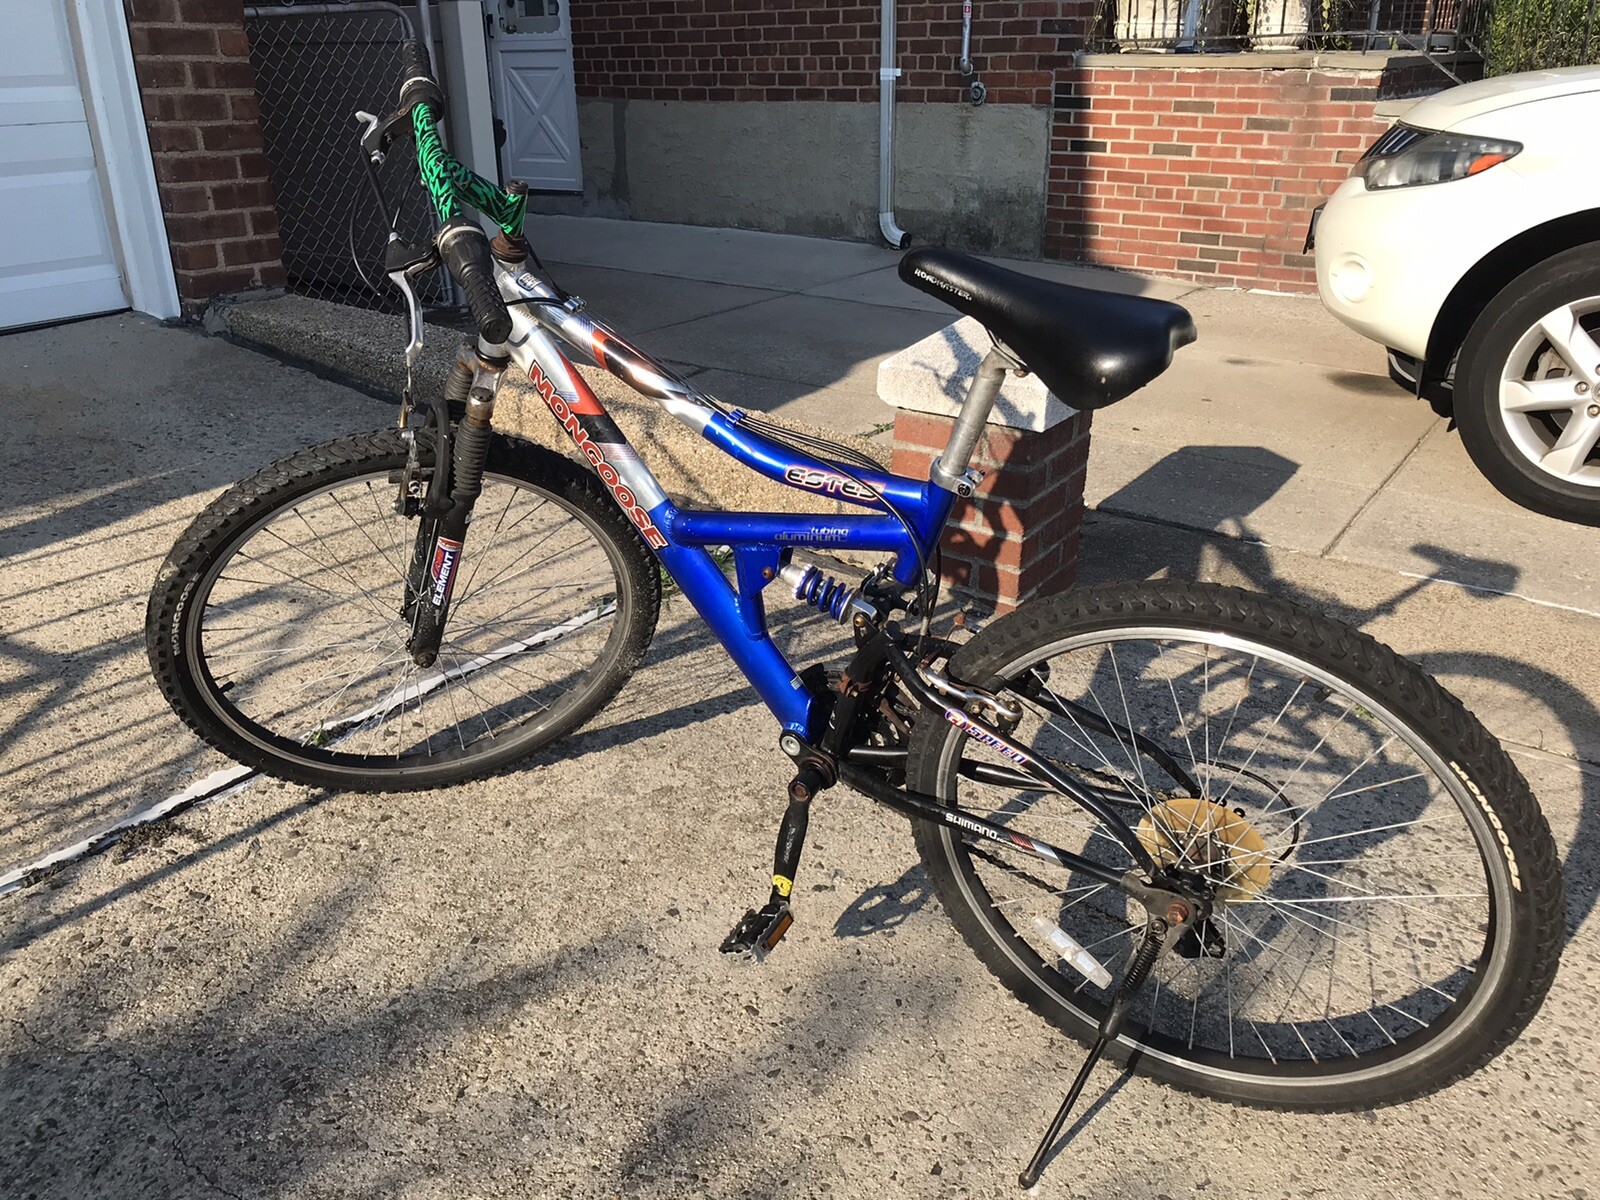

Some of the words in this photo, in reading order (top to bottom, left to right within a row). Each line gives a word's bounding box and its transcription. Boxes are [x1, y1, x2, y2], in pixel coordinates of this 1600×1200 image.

[914, 268, 970, 300] ROADMASTER
[528, 360, 667, 549] MONGOOSE
[785, 465, 886, 500] ESTES
[774, 531, 841, 541] aluminum
[811, 526, 849, 536] tubing
[432, 551, 454, 606] ELEMENT
[966, 725, 1026, 764] SPEED
[945, 812, 997, 840] SHIMANO
[1450, 761, 1521, 892] MONGOOSE
